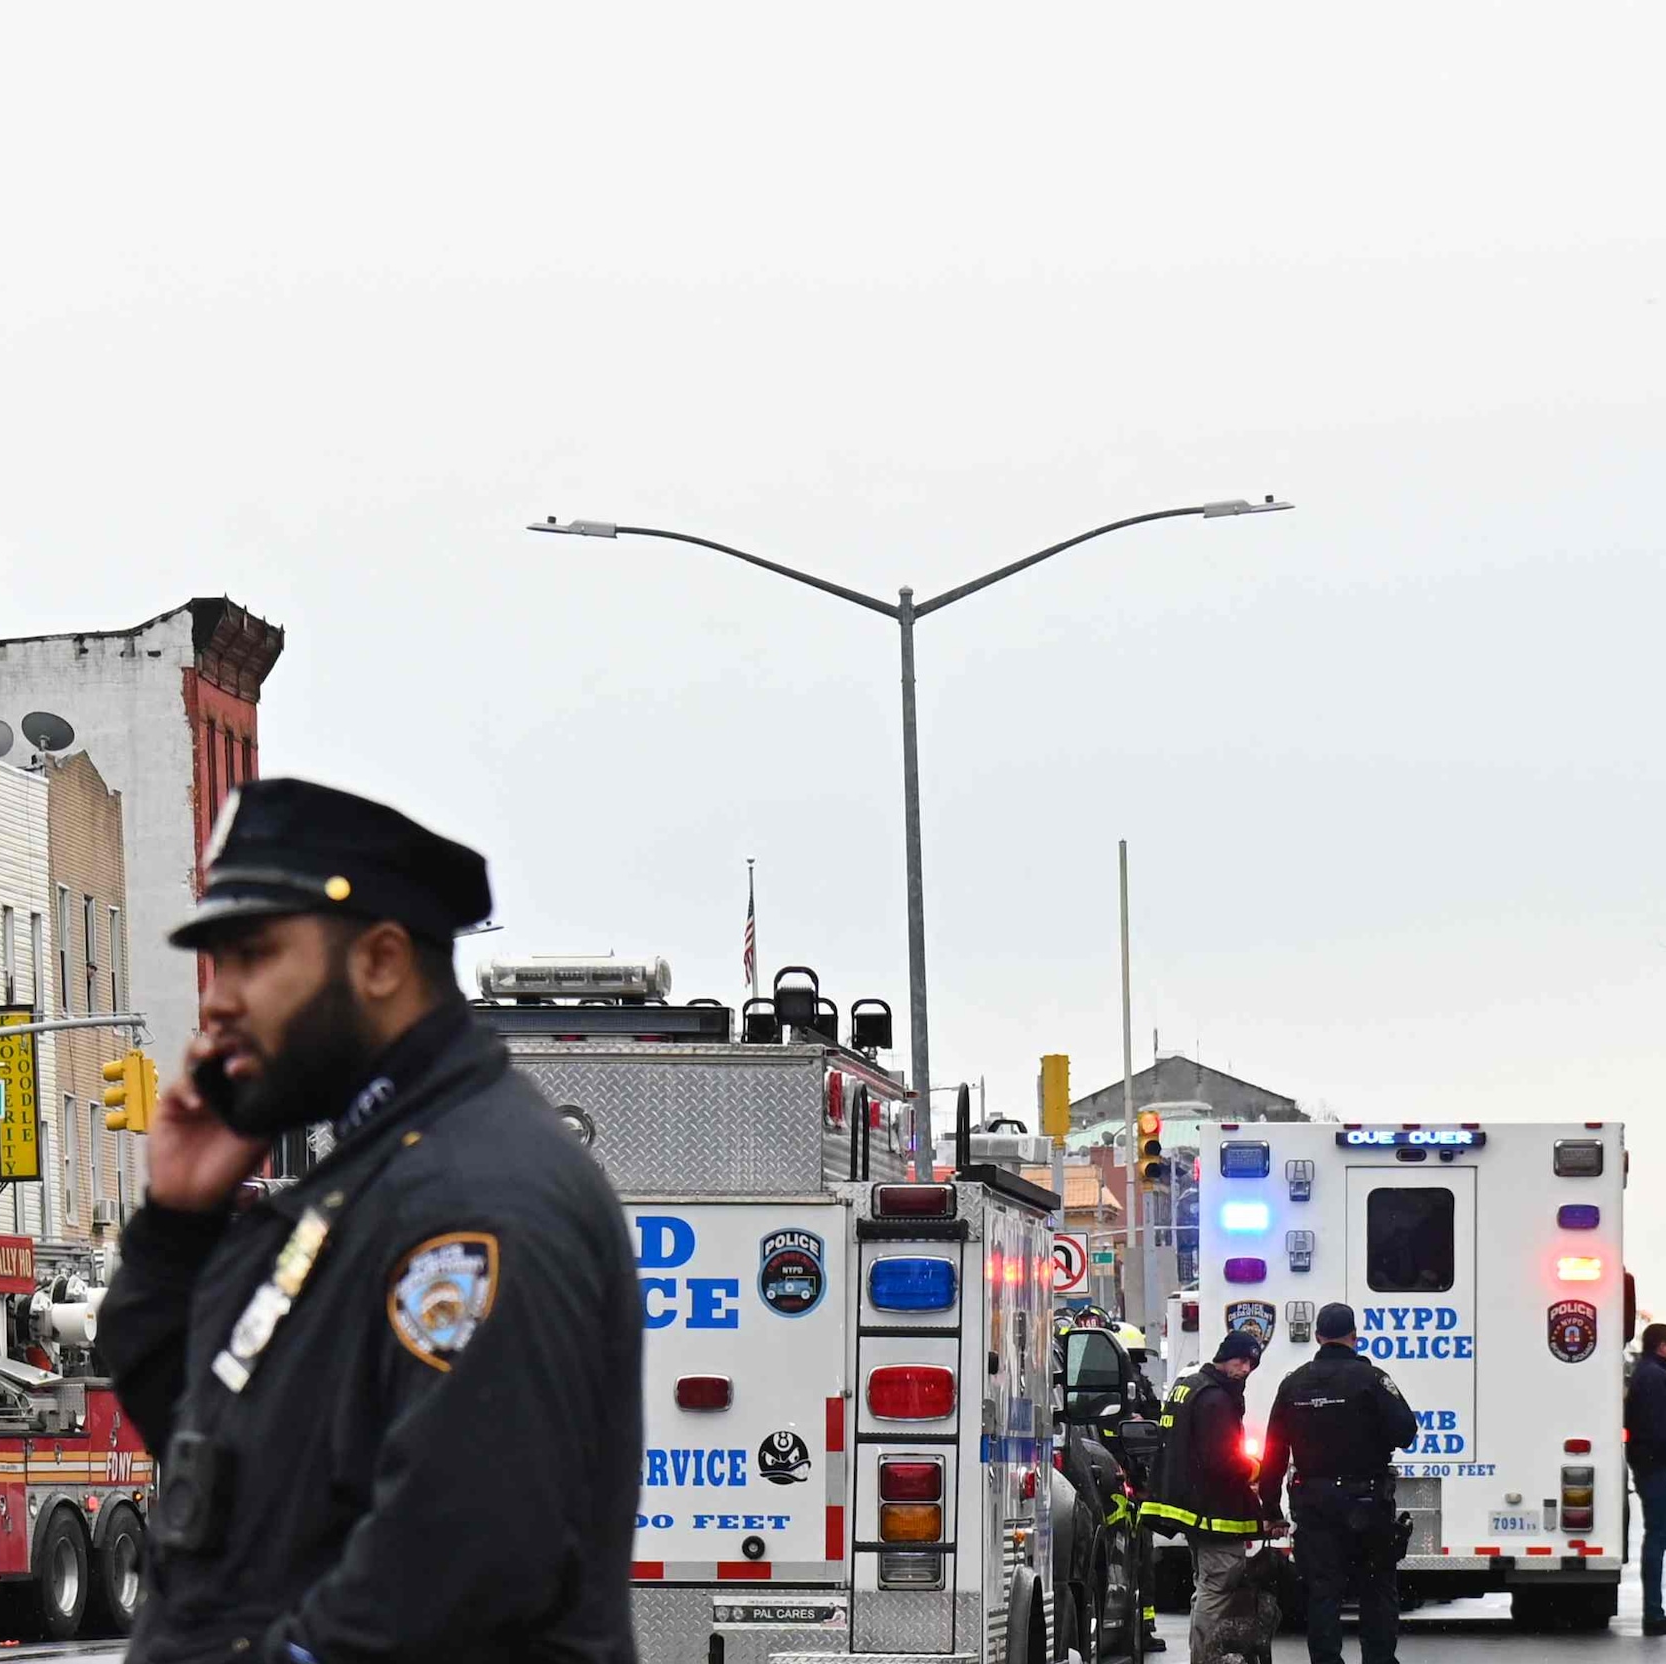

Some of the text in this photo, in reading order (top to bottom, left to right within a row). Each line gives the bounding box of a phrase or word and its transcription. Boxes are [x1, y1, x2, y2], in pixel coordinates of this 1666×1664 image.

[18, 1043, 33, 1142] NOODLE
[765, 1233, 819, 1256] POLICE
[18, 1249, 32, 1278] HO
[1237, 1303, 1264, 1311] POLICE
[1550, 1303, 1594, 1321] POLICE
[1363, 1308, 1458, 1331] NYPD
[1356, 1336, 1473, 1359] POLICE
[106, 1451, 133, 1482] FDNY
[639, 1449, 747, 1487] RVICE
[1422, 1465, 1451, 1477] 200
[1458, 1464, 1496, 1476] FEET
[693, 1514, 791, 1529] FEET
[1493, 1517, 1524, 1530] 7091
[753, 1609, 815, 1619] PAL CARES
